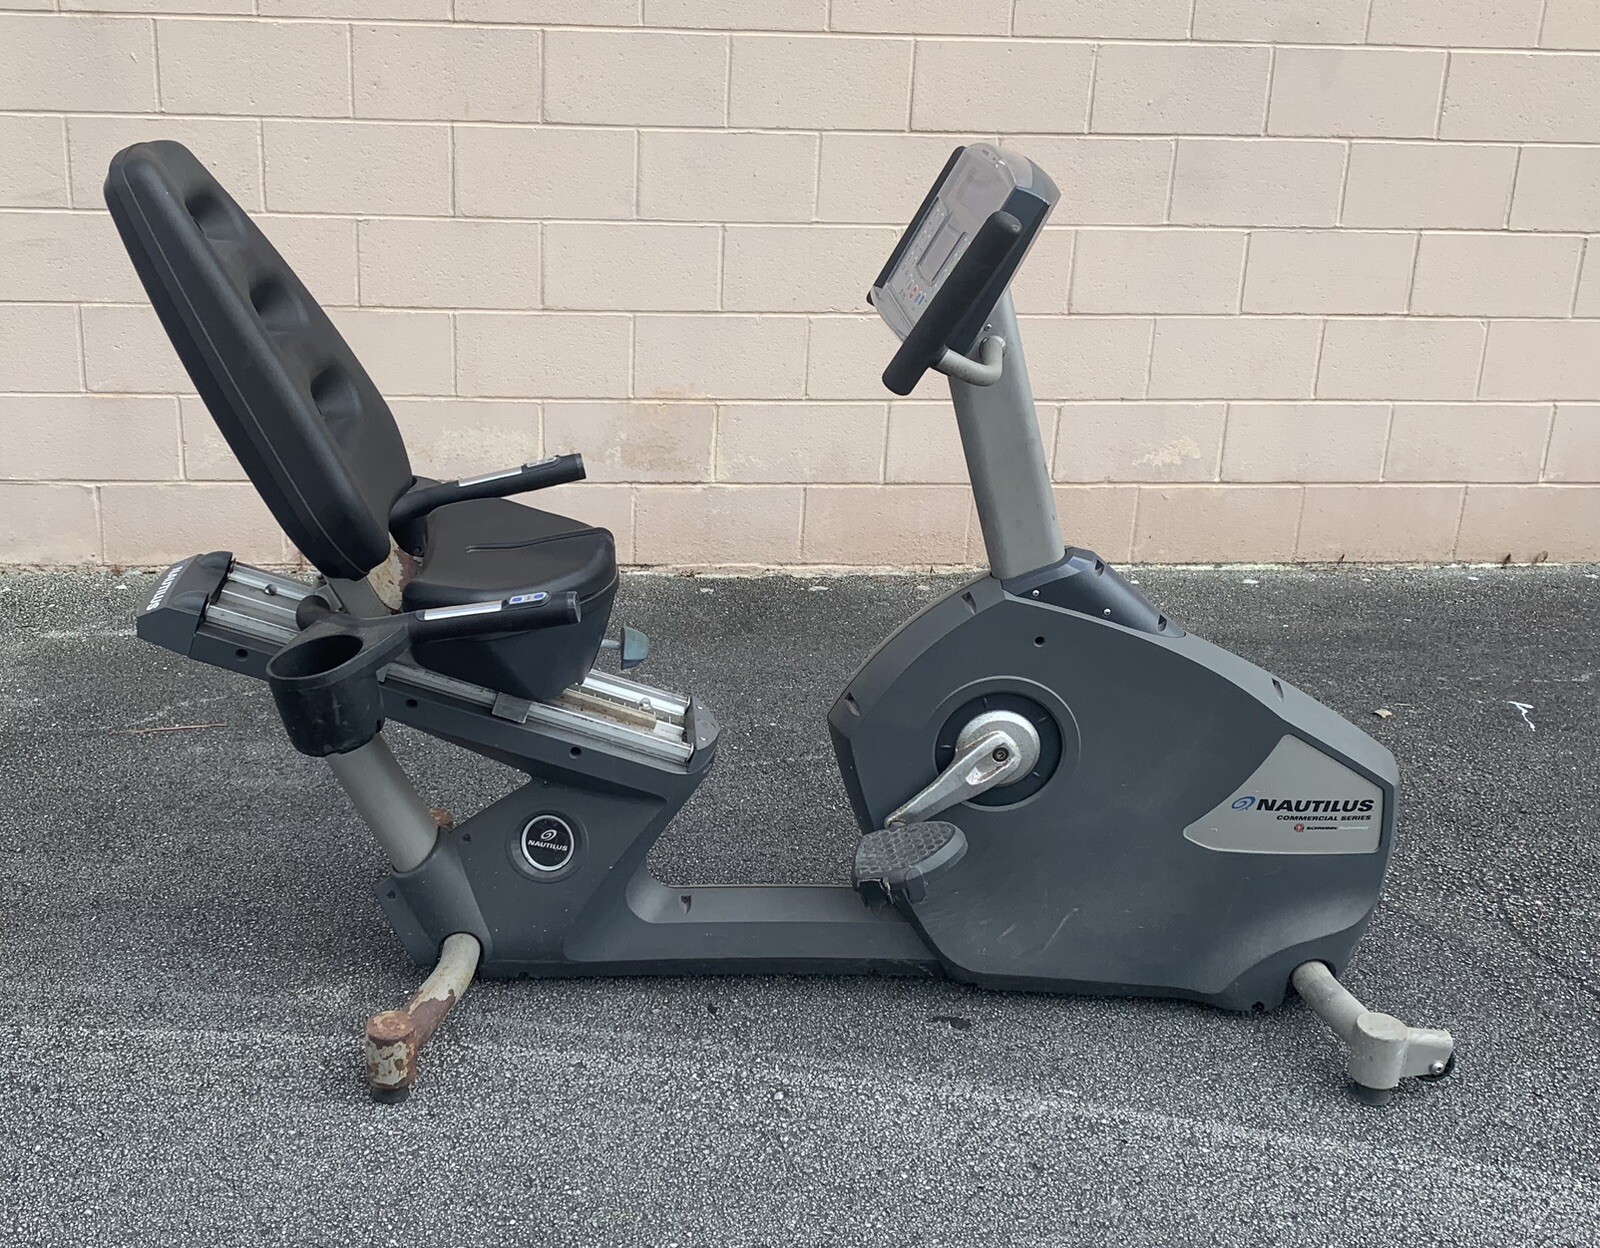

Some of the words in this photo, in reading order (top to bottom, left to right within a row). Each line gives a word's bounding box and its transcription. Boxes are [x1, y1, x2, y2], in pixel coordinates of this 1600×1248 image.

[146, 565, 183, 611] NAUTILUS
[1256, 799, 1374, 813] NAUTILUS
[528, 839, 568, 851] NAUTILUS
